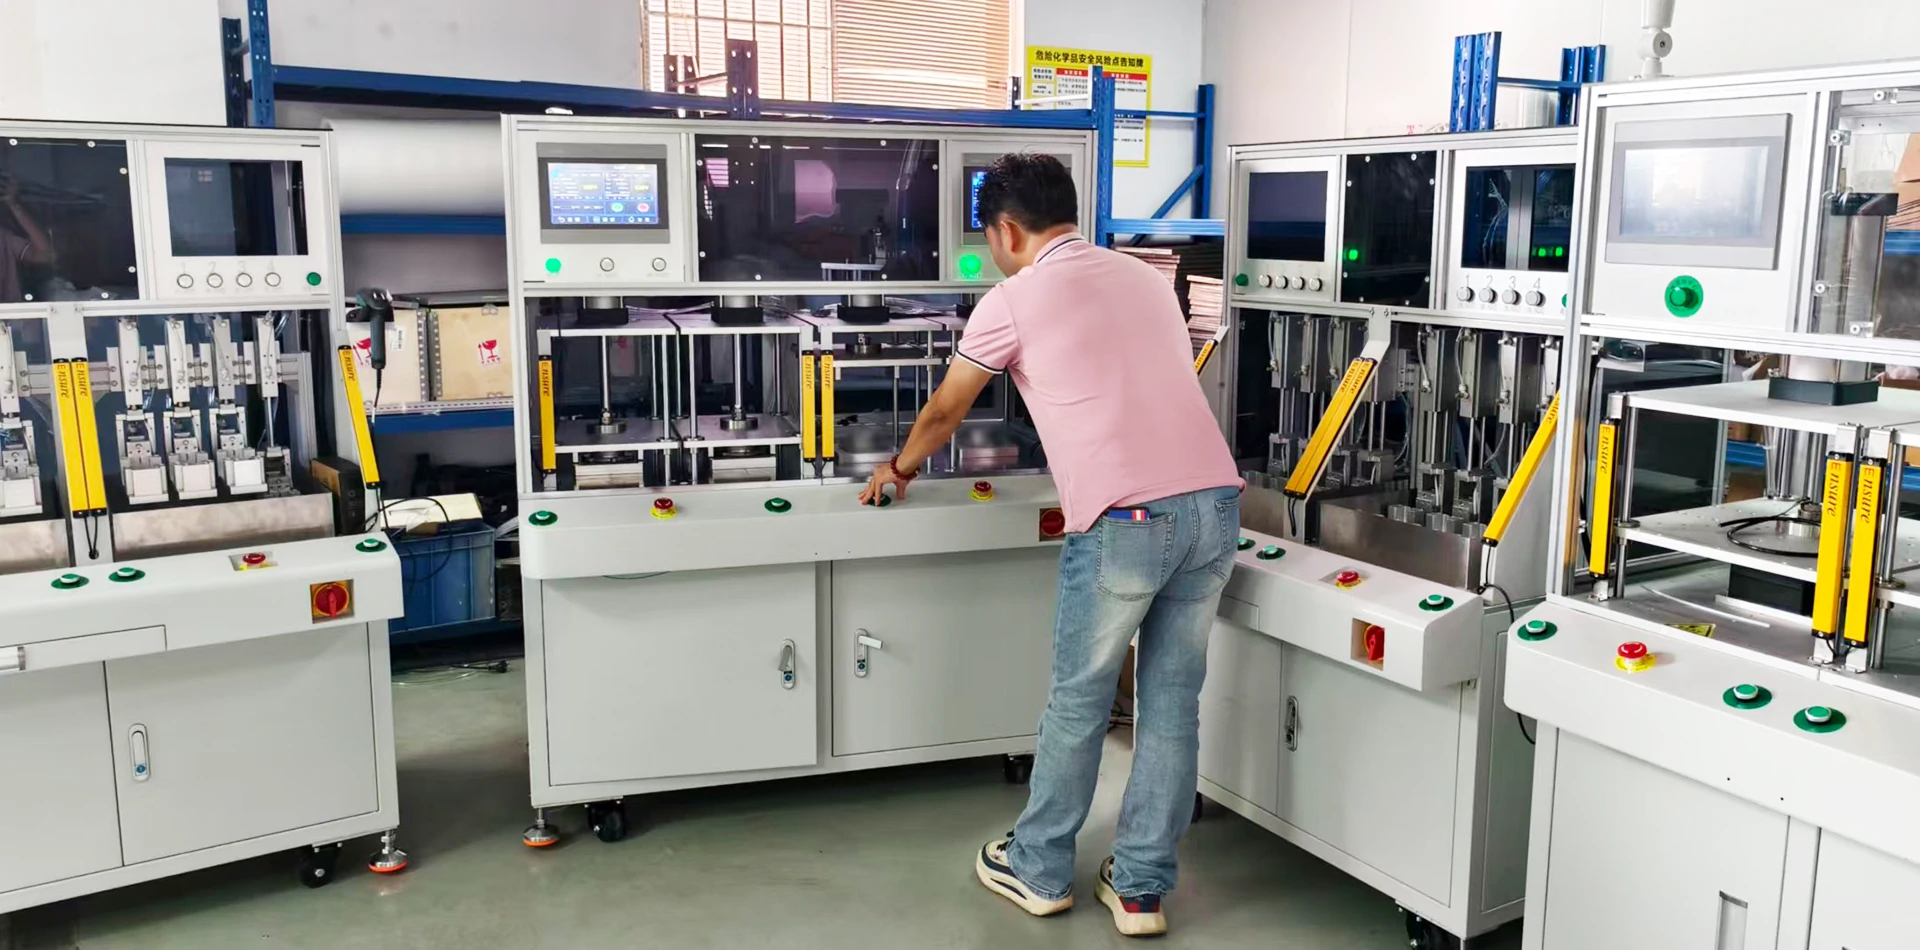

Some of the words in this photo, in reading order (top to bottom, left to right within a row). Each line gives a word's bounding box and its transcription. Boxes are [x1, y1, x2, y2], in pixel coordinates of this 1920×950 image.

[1486, 275, 1493, 288] 2
[1509, 276, 1516, 290] 3
[1533, 277, 1541, 291] 4
[57, 364, 70, 398] Ensure
[76, 362, 88, 397] Ensure
[541, 361, 550, 397] Ensure
[1600, 426, 1611, 474] Ensure
[1827, 462, 1842, 517] Ensure
[1861, 468, 1875, 524] Ensure
